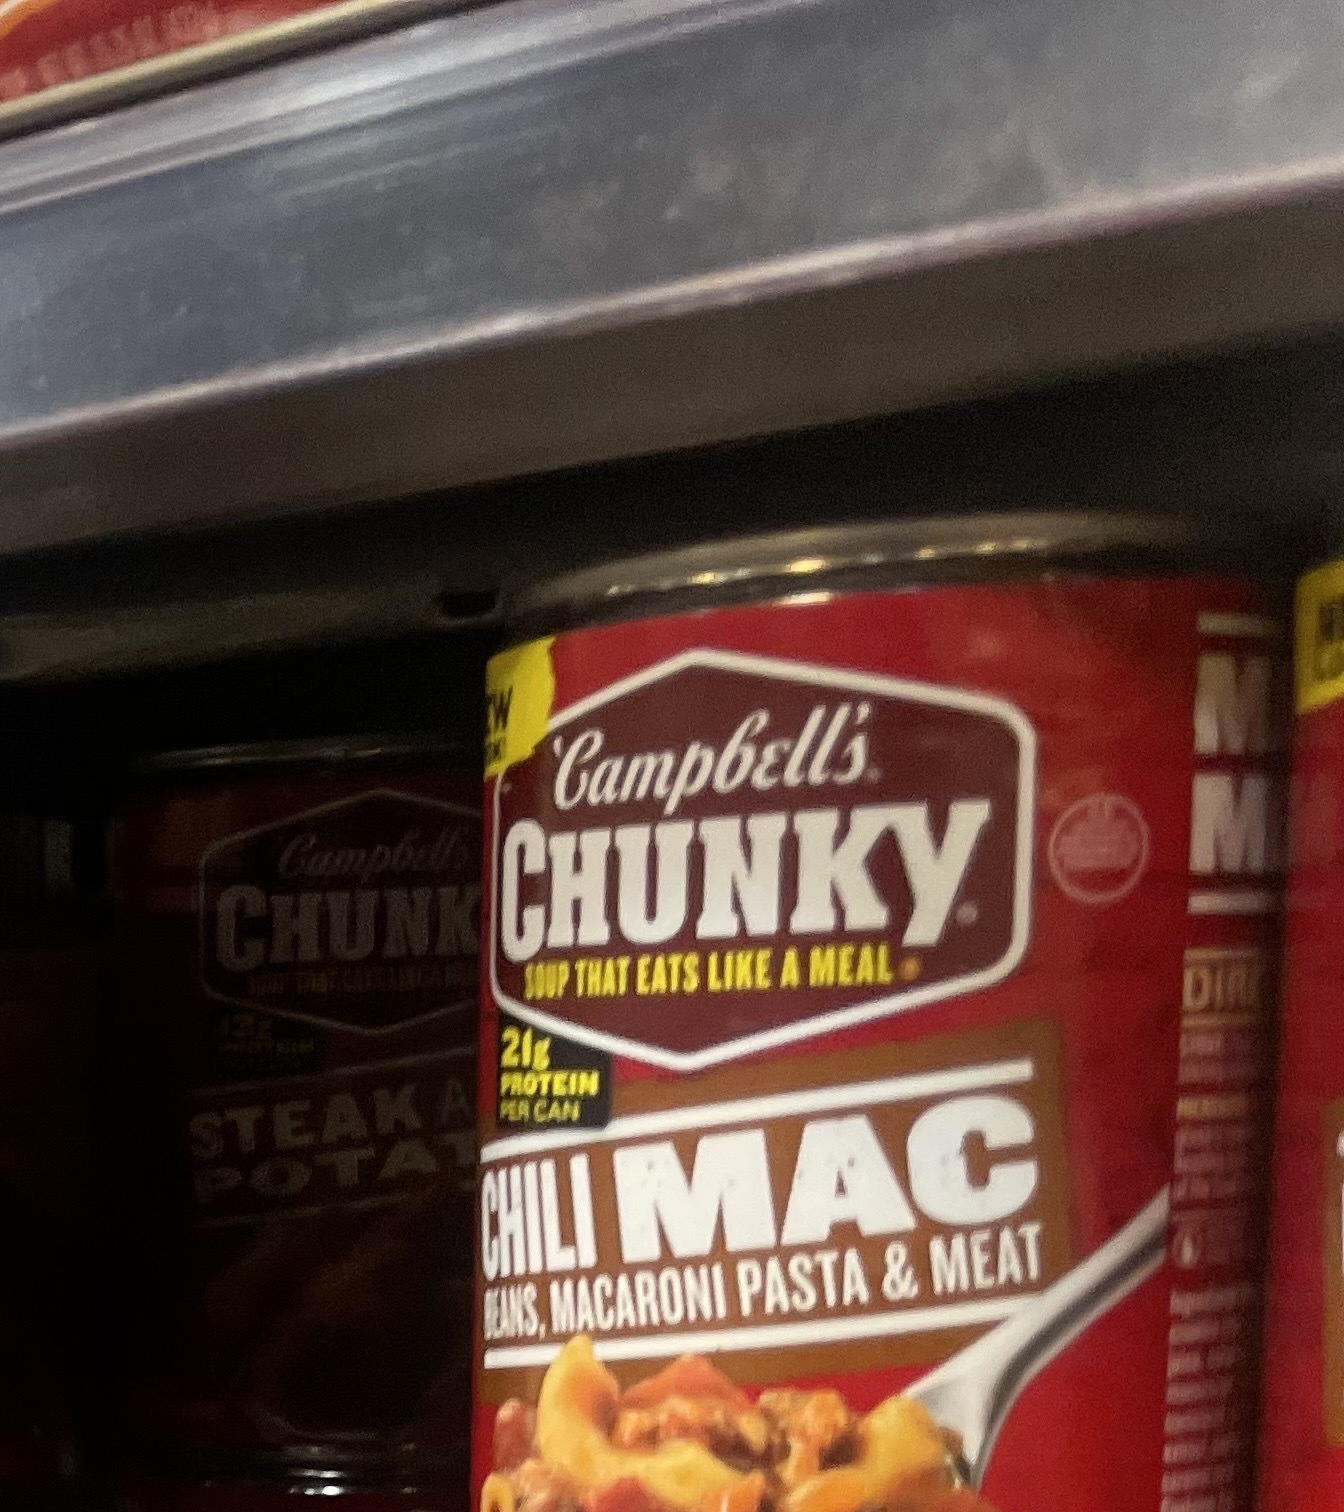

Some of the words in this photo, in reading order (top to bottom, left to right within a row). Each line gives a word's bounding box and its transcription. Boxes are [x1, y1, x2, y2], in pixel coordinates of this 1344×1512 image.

[551, 700, 872, 816] Campbell's
[500, 799, 992, 965] CHUNKY
[214, 882, 480, 972] CHUNK
[524, 956, 567, 1001] SOUP
[573, 955, 629, 998] THAT
[635, 952, 700, 997] EATS
[707, 946, 774, 994] LIKE
[779, 946, 799, 990] A
[810, 945, 893, 987] MEAL
[499, 1067, 600, 1098] PROTEIN
[500, 1026, 552, 1071] 21g
[187, 1076, 422, 1164] STEAK
[192, 1129, 478, 1205] POTAT
[480, 1151, 599, 1283] CHILI
[611, 1093, 1041, 1265] MAC
[549, 1262, 728, 1333] MACARONI
[737, 1246, 871, 1316] PASTA
[881, 1241, 920, 1300] &
[928, 1221, 1043, 1297] MEAT
